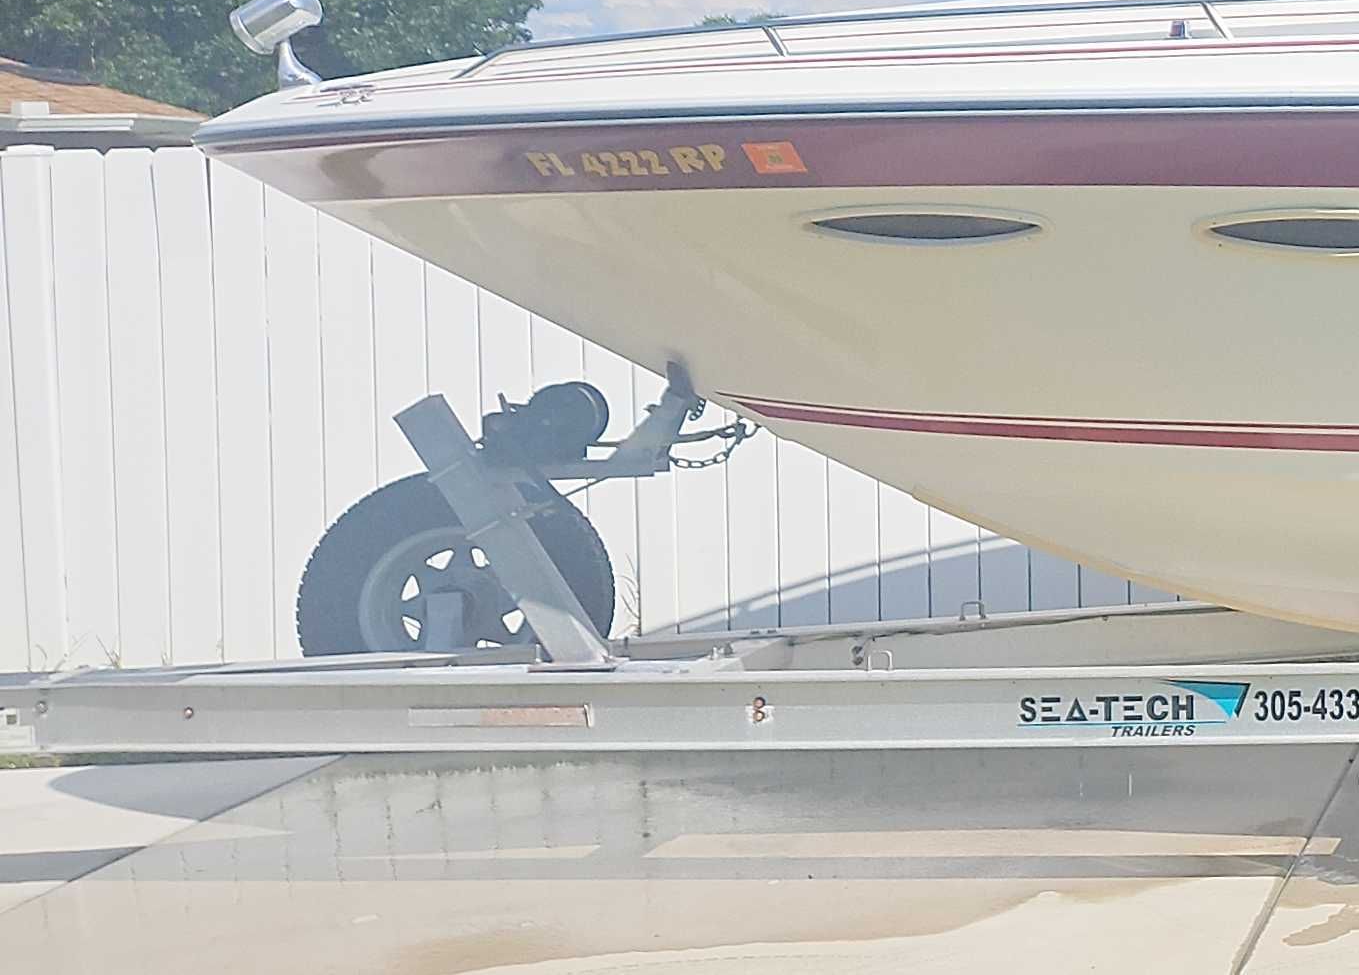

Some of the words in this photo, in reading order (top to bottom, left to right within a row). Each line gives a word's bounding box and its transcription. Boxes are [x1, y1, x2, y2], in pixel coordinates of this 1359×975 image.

[526, 151, 576, 177] FL
[581, 149, 670, 177] 4222
[669, 143, 727, 175] RP
[1019, 694, 1195, 723] SEA-TECH
[1110, 724, 1196, 738] TRAILERS
